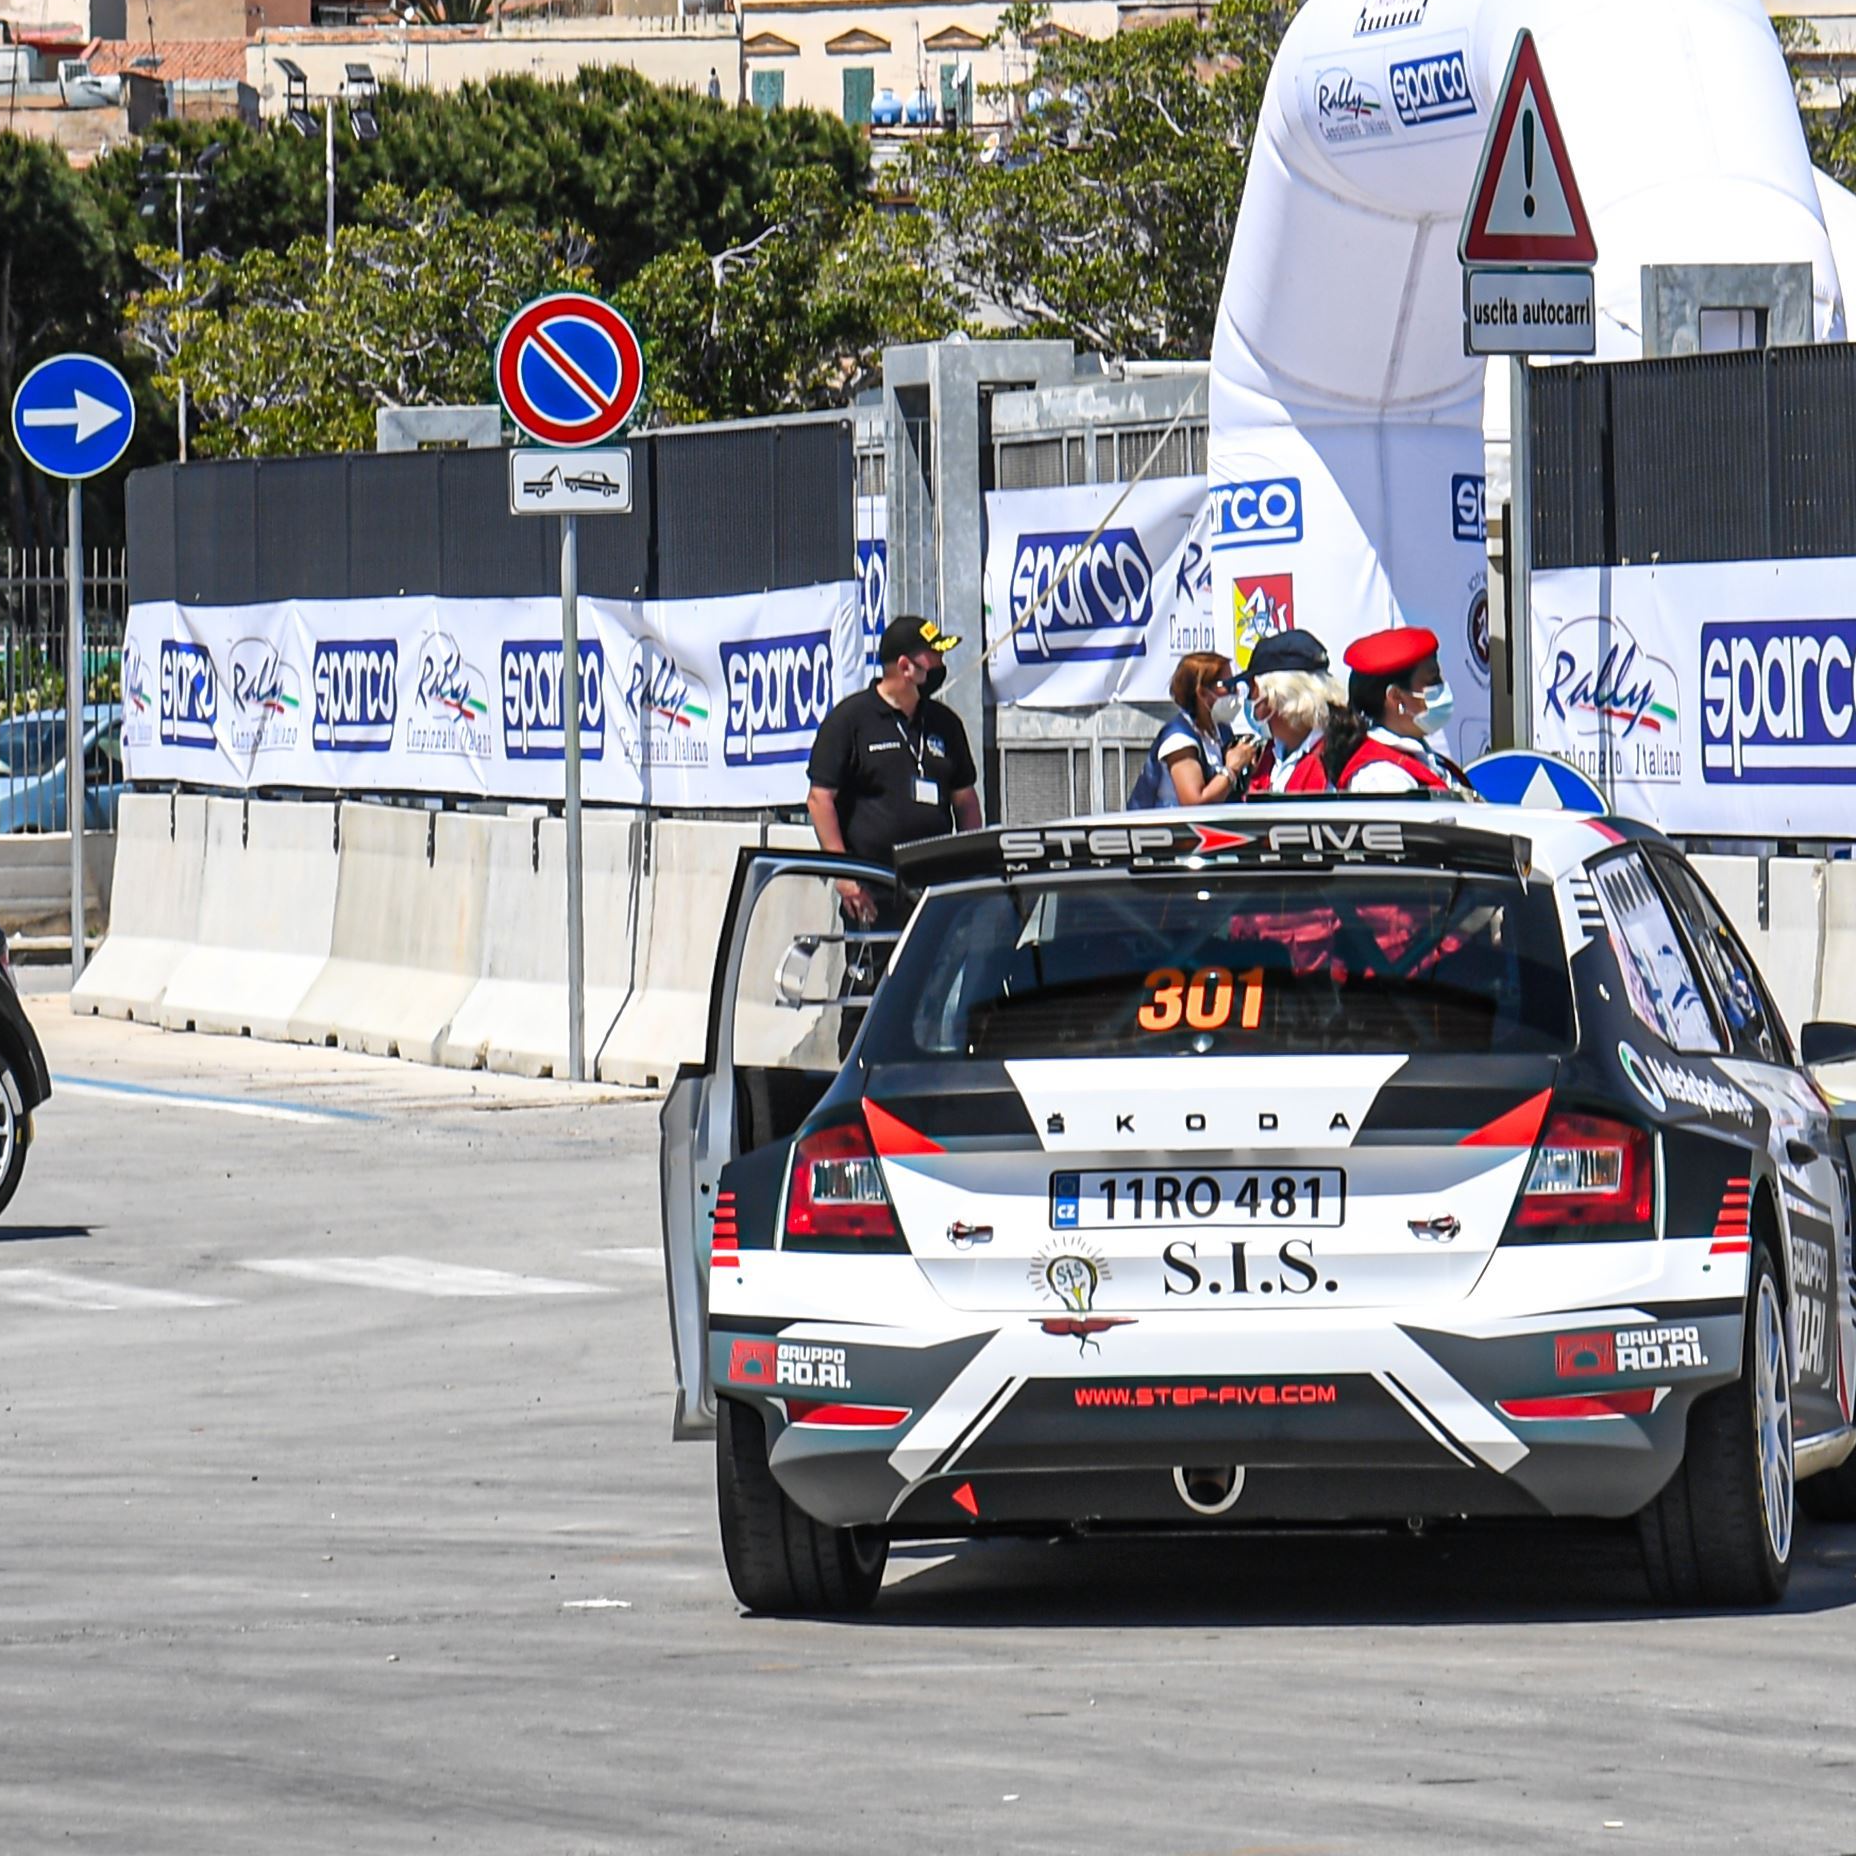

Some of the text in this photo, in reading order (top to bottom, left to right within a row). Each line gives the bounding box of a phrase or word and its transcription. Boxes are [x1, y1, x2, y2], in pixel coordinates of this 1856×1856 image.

[1318, 75, 1364, 119] Rally
[1393, 56, 1467, 122] sparco
[1473, 295, 1591, 326] uscita autocarri
[1014, 541, 1150, 660] sparco
[314, 649, 394, 747] sparco
[729, 642, 833, 762] sparco
[1543, 641, 1657, 739] Rally
[1635, 744, 1683, 777] Italiano
[998, 822, 1404, 860] STEP FIVE
[1137, 966, 1265, 1031] 301
[1046, 1112, 1350, 1134] ŠKODA
[1056, 1204, 1077, 1219] CZ
[1098, 1176, 1323, 1221] 11RO 481
[1163, 1239, 1340, 1296] S.I.S.
[778, 1344, 846, 1364] GRUPPO
[1615, 1326, 1699, 1346] GRUPPO
[777, 1363, 852, 1389] RO.RI.
[1614, 1344, 1709, 1373] RO.RI.
[1074, 1385, 1336, 1408] WWW.STEP-FIVE.COM
